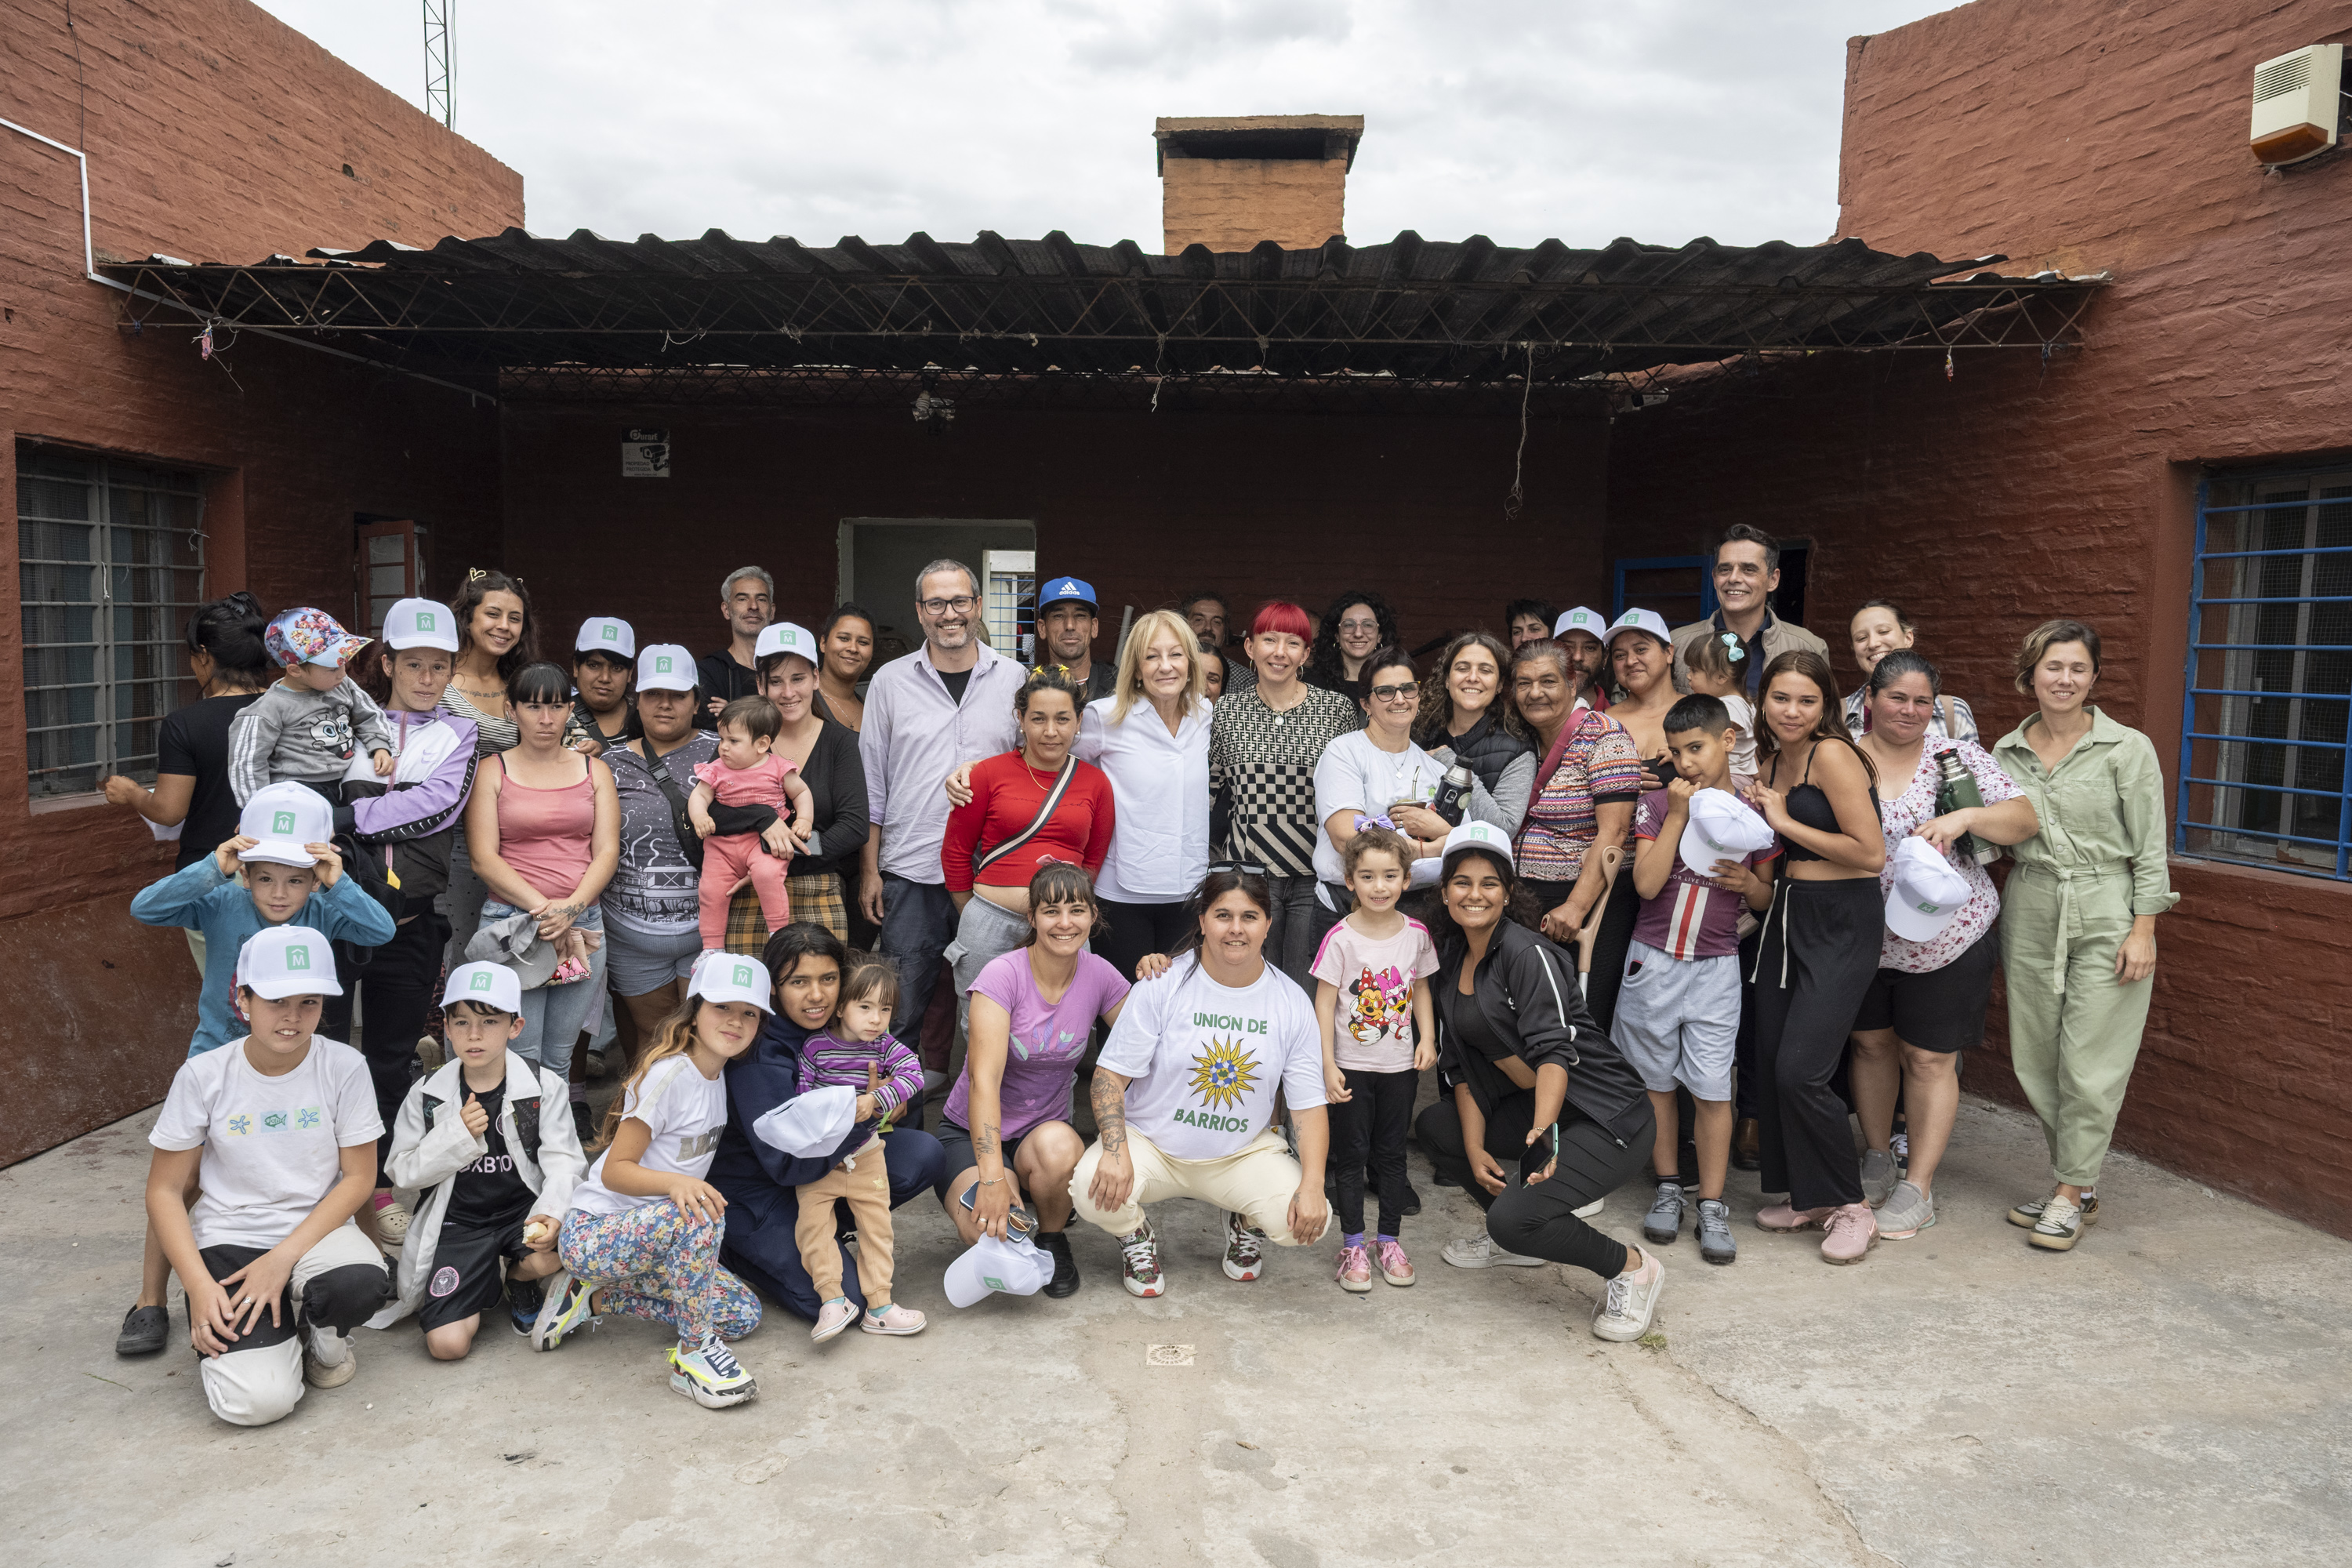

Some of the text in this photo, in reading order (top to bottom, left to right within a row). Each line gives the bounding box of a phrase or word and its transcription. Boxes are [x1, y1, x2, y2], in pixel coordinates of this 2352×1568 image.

[1684, 876, 1700, 884] LIVE
[1193, 1012, 1268, 1035] UNIÓN DE
[1173, 1108, 1250, 1133] BARRIOS
